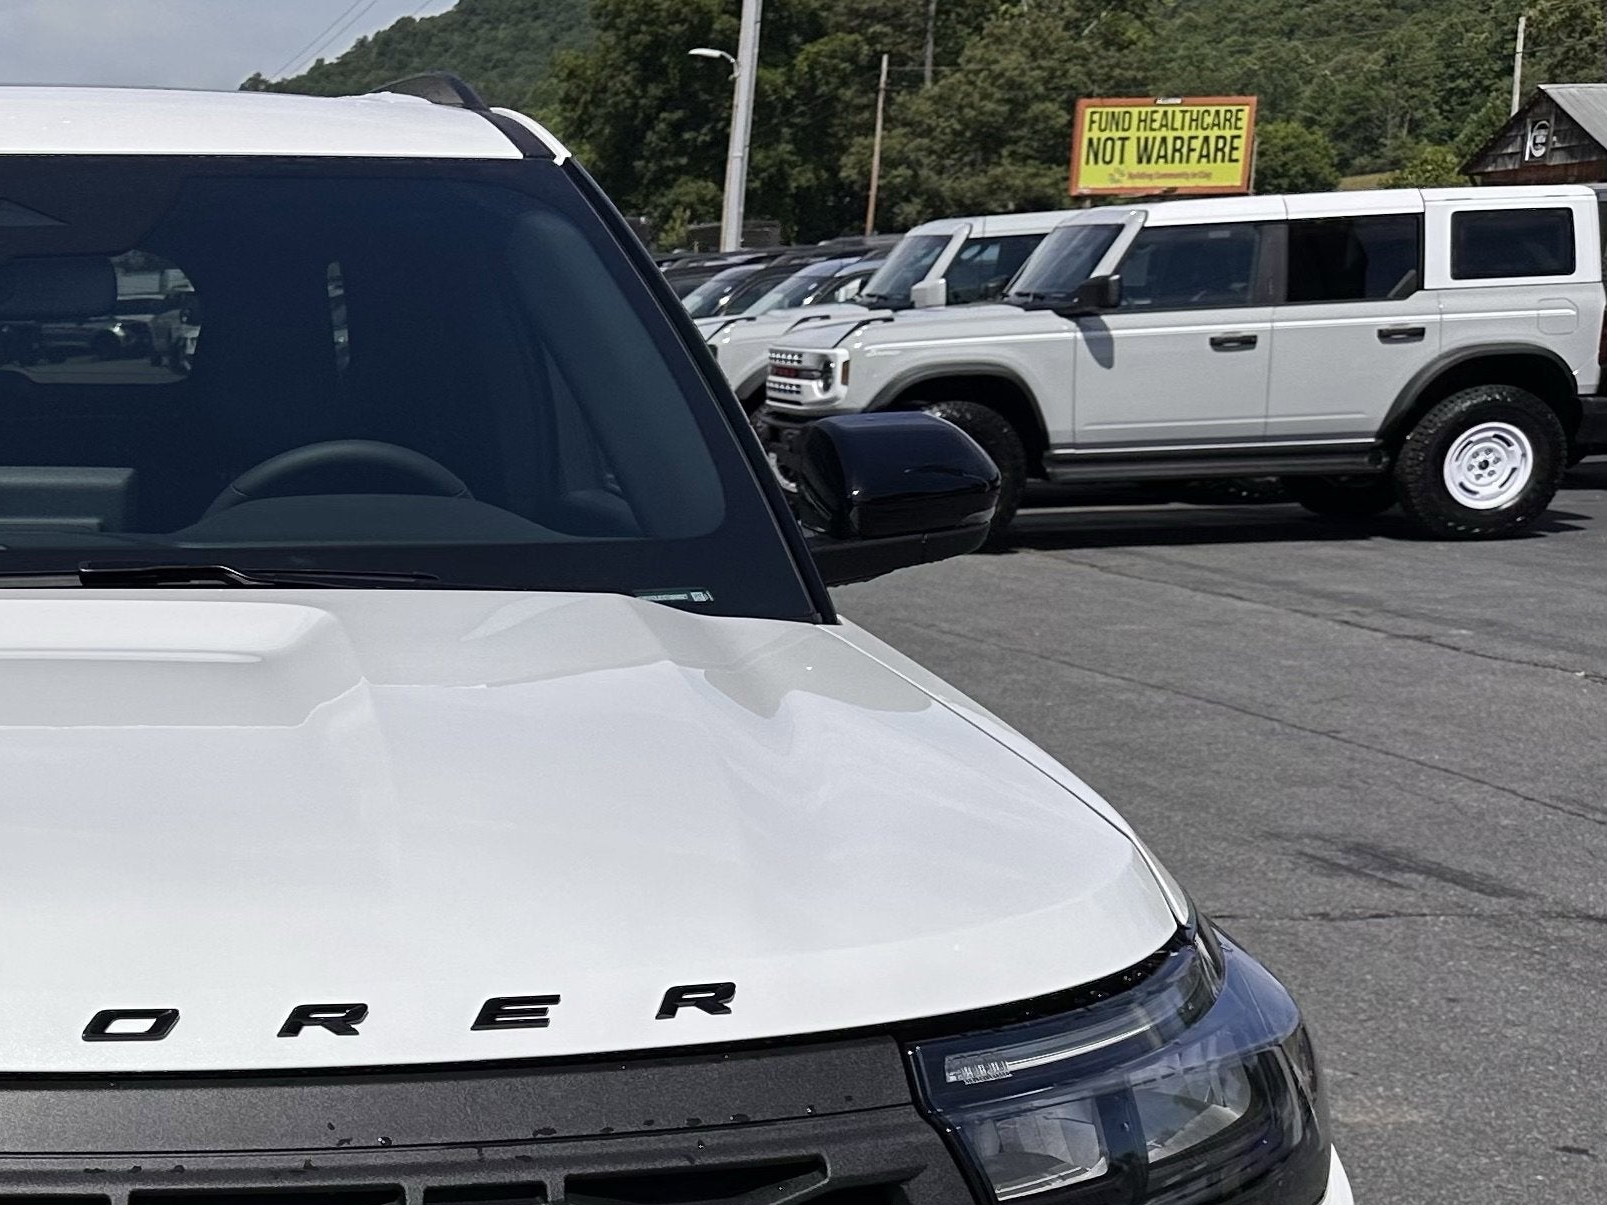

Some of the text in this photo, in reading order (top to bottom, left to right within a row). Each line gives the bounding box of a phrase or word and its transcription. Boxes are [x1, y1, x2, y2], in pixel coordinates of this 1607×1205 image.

[1088, 108, 1245, 132] FUND HEALTHCARE
[1085, 135, 1242, 165] NOT WARFARE
